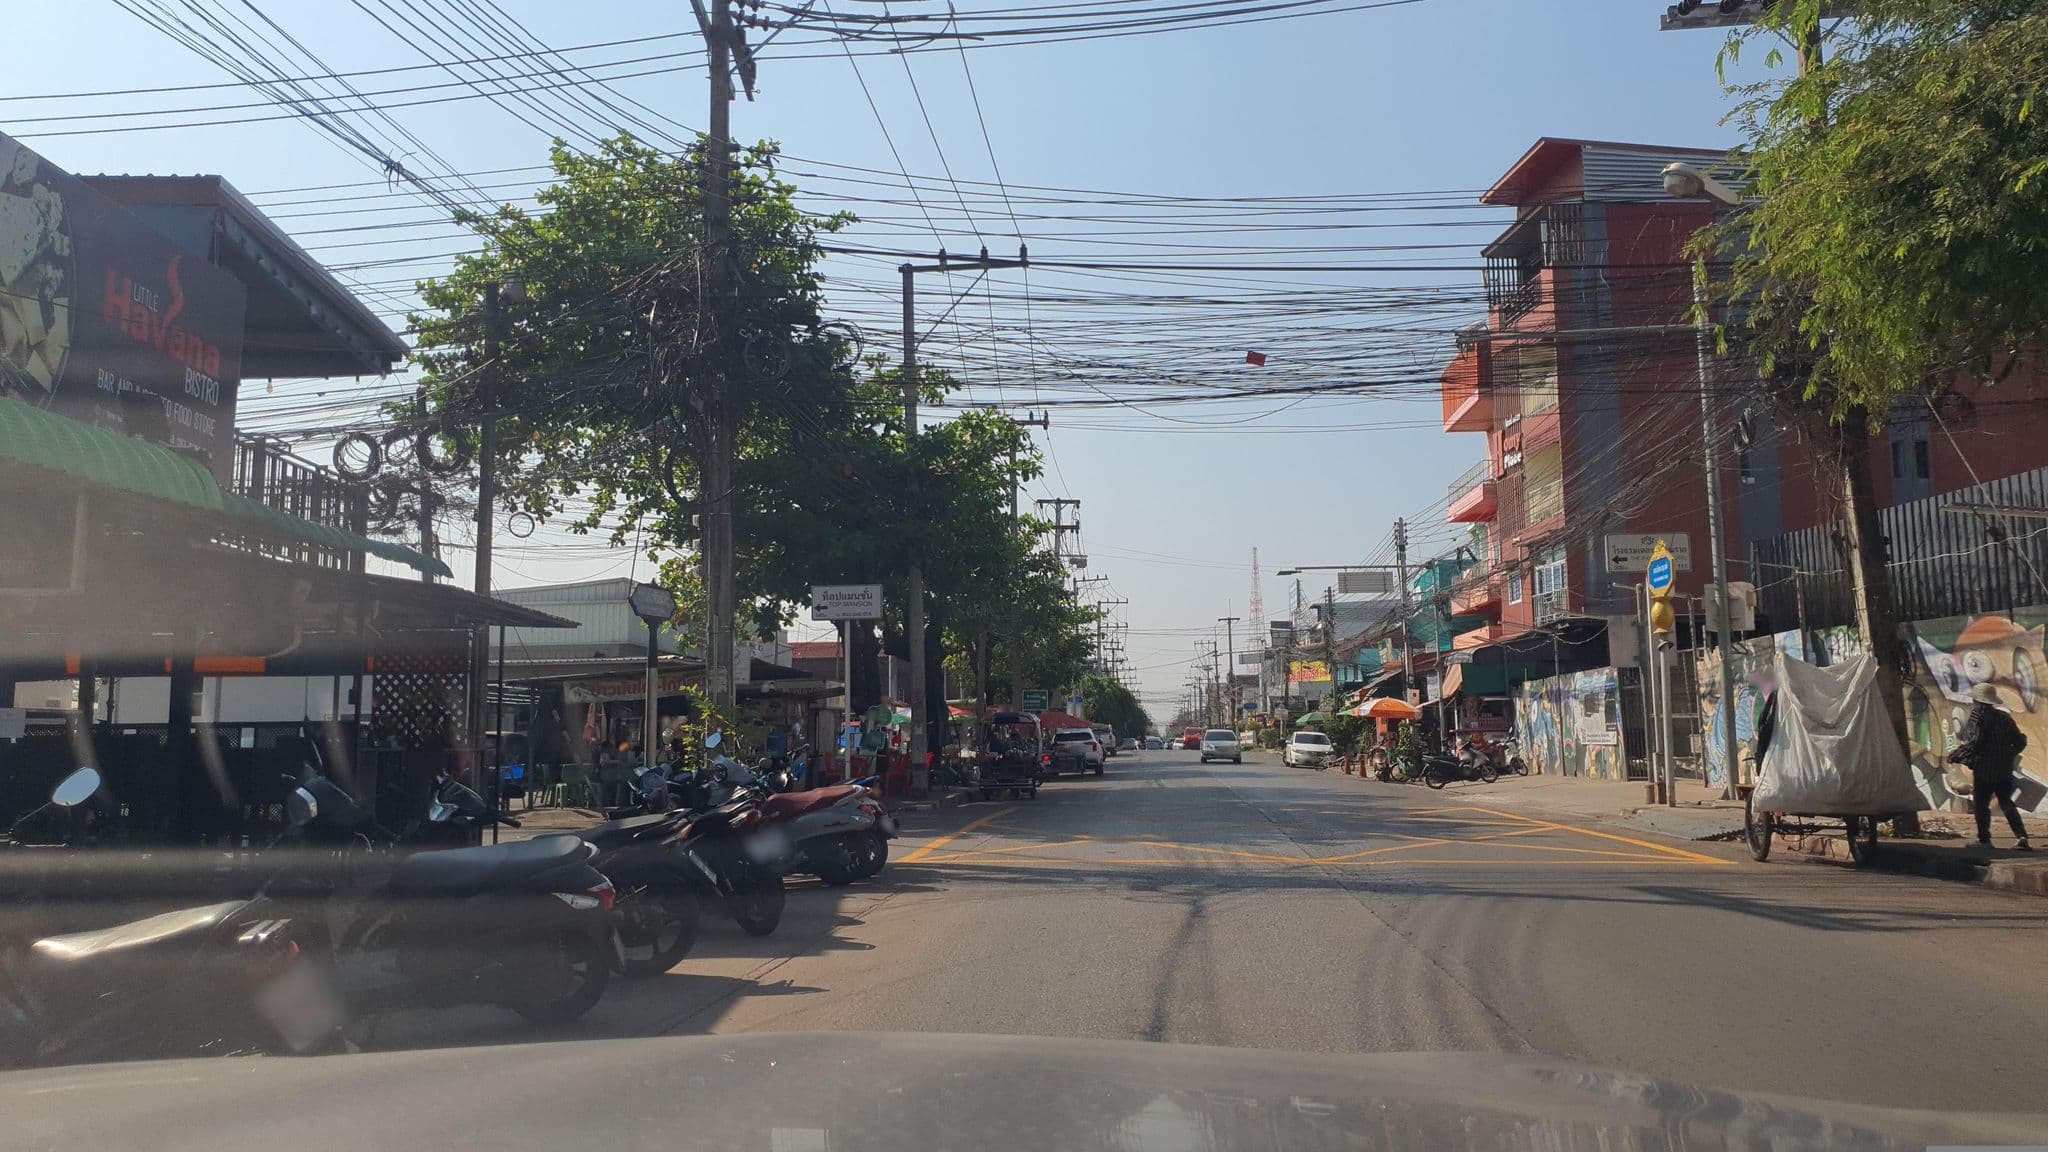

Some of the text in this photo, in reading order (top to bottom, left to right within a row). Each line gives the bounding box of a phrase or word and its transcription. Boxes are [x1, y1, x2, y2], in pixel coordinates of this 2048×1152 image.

[104, 257, 220, 378] Havana
[133, 283, 160, 312] LITTLE
[97, 368, 115, 393] BAR
[173, 402, 192, 427] FOOD
[193, 412, 216, 434] STORE
[184, 367, 220, 406] BISTRO
